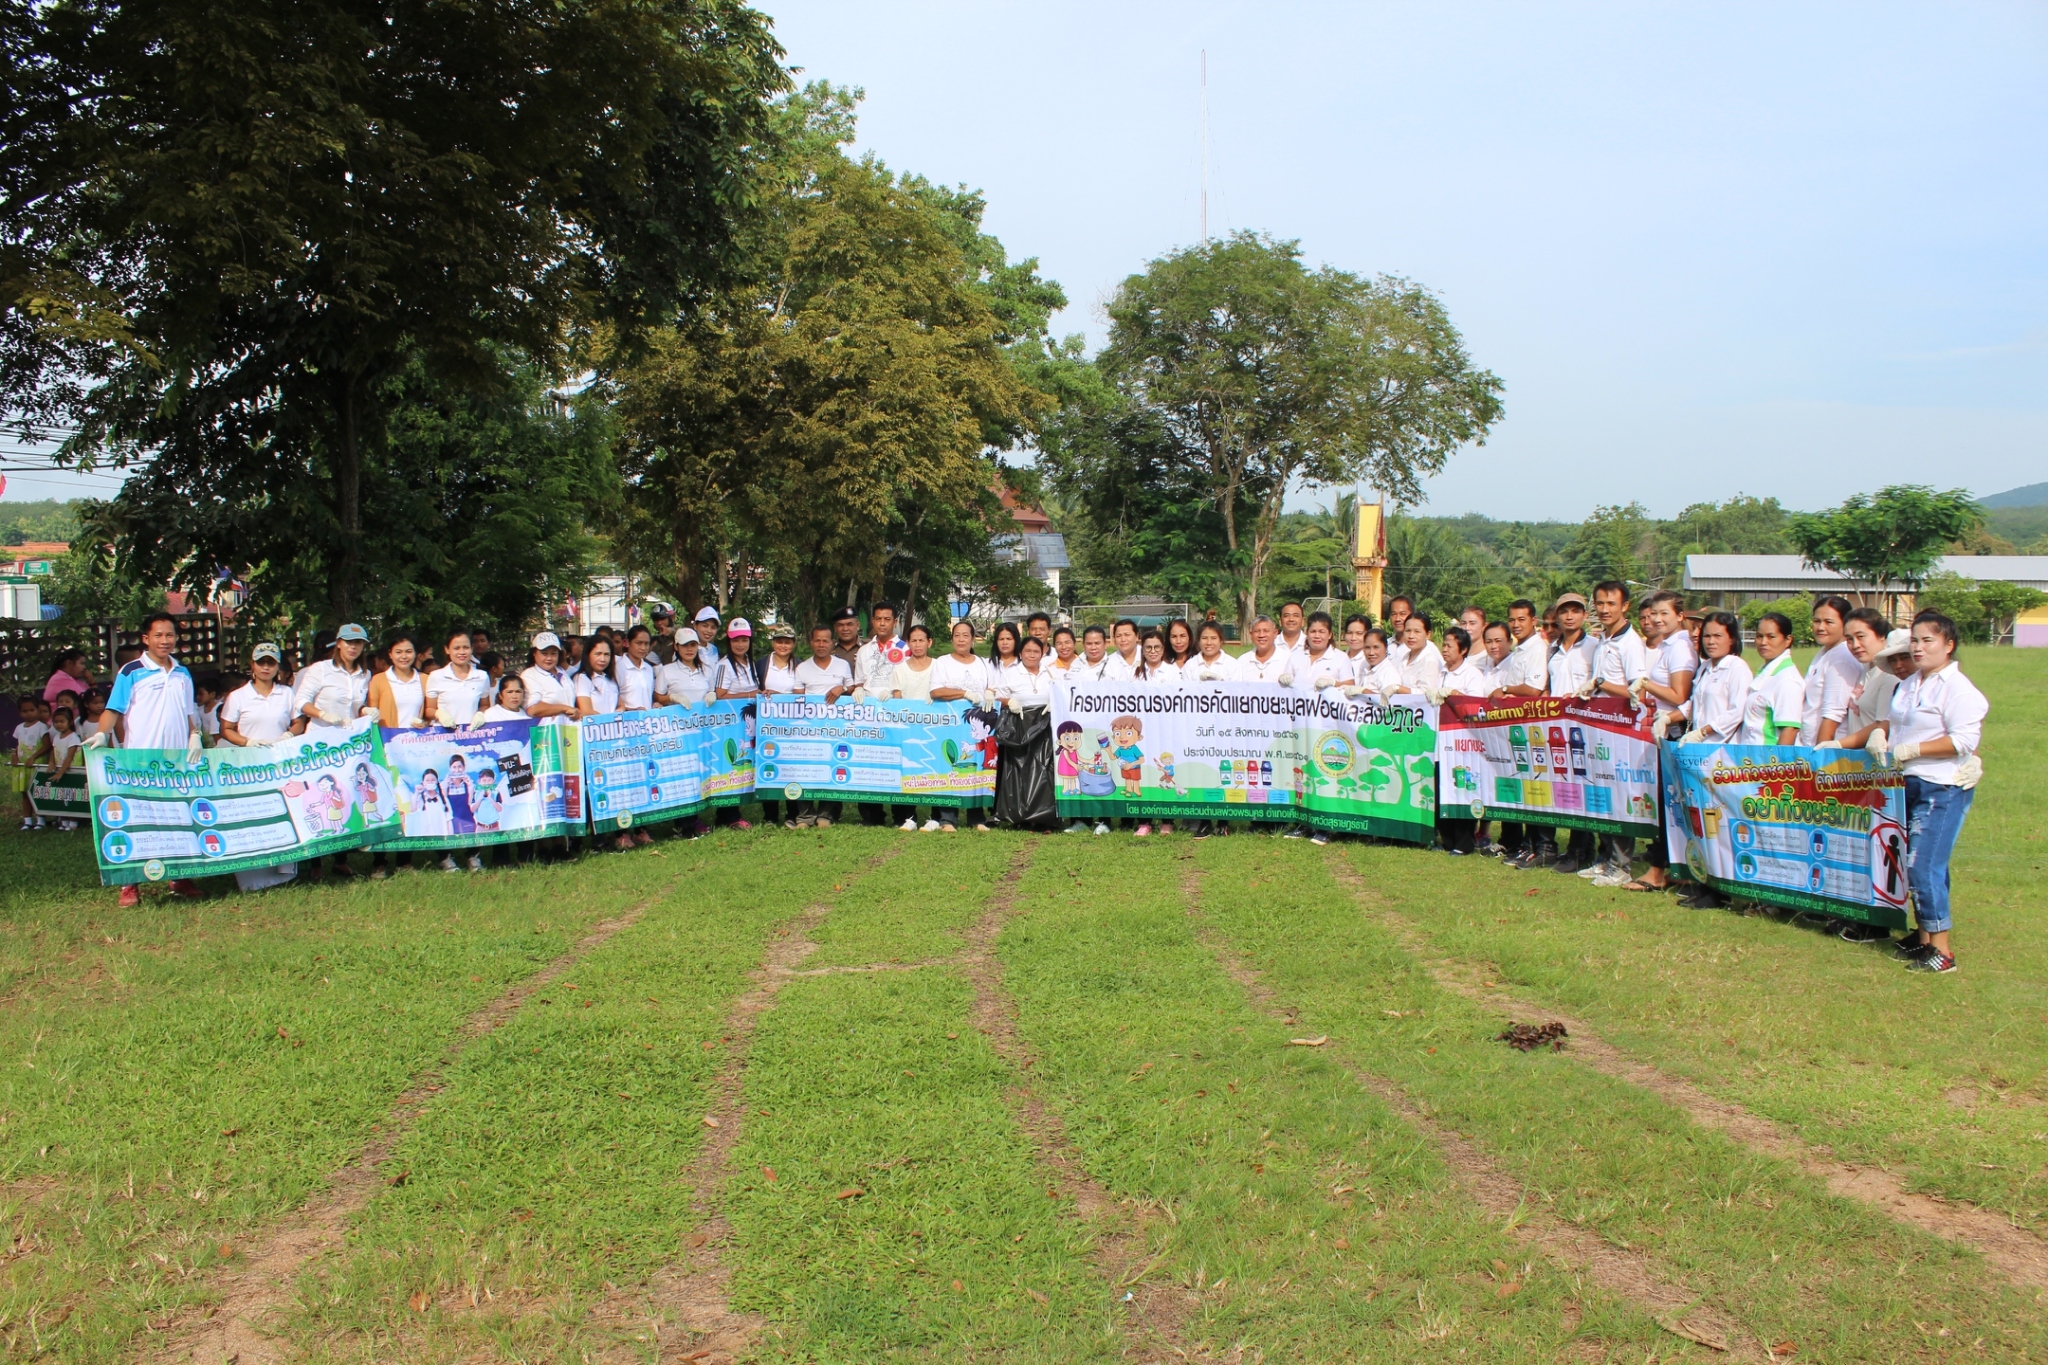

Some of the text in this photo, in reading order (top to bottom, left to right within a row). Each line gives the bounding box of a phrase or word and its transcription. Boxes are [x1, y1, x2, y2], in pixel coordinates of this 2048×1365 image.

[539, 634, 557, 642] NYC
[1069, 686, 1424, 732] โครงการรณรงค์การคัดแยกขยะมูลฝอยและสิ่งปฏิกูล
[1195, 724, 1215, 737] วันที่
[1234, 727, 1269, 738] สิงหาคม
[1183, 746, 1261, 758] ประจำปีงบประมาณ
[1126, 805, 1139, 815] โดย
